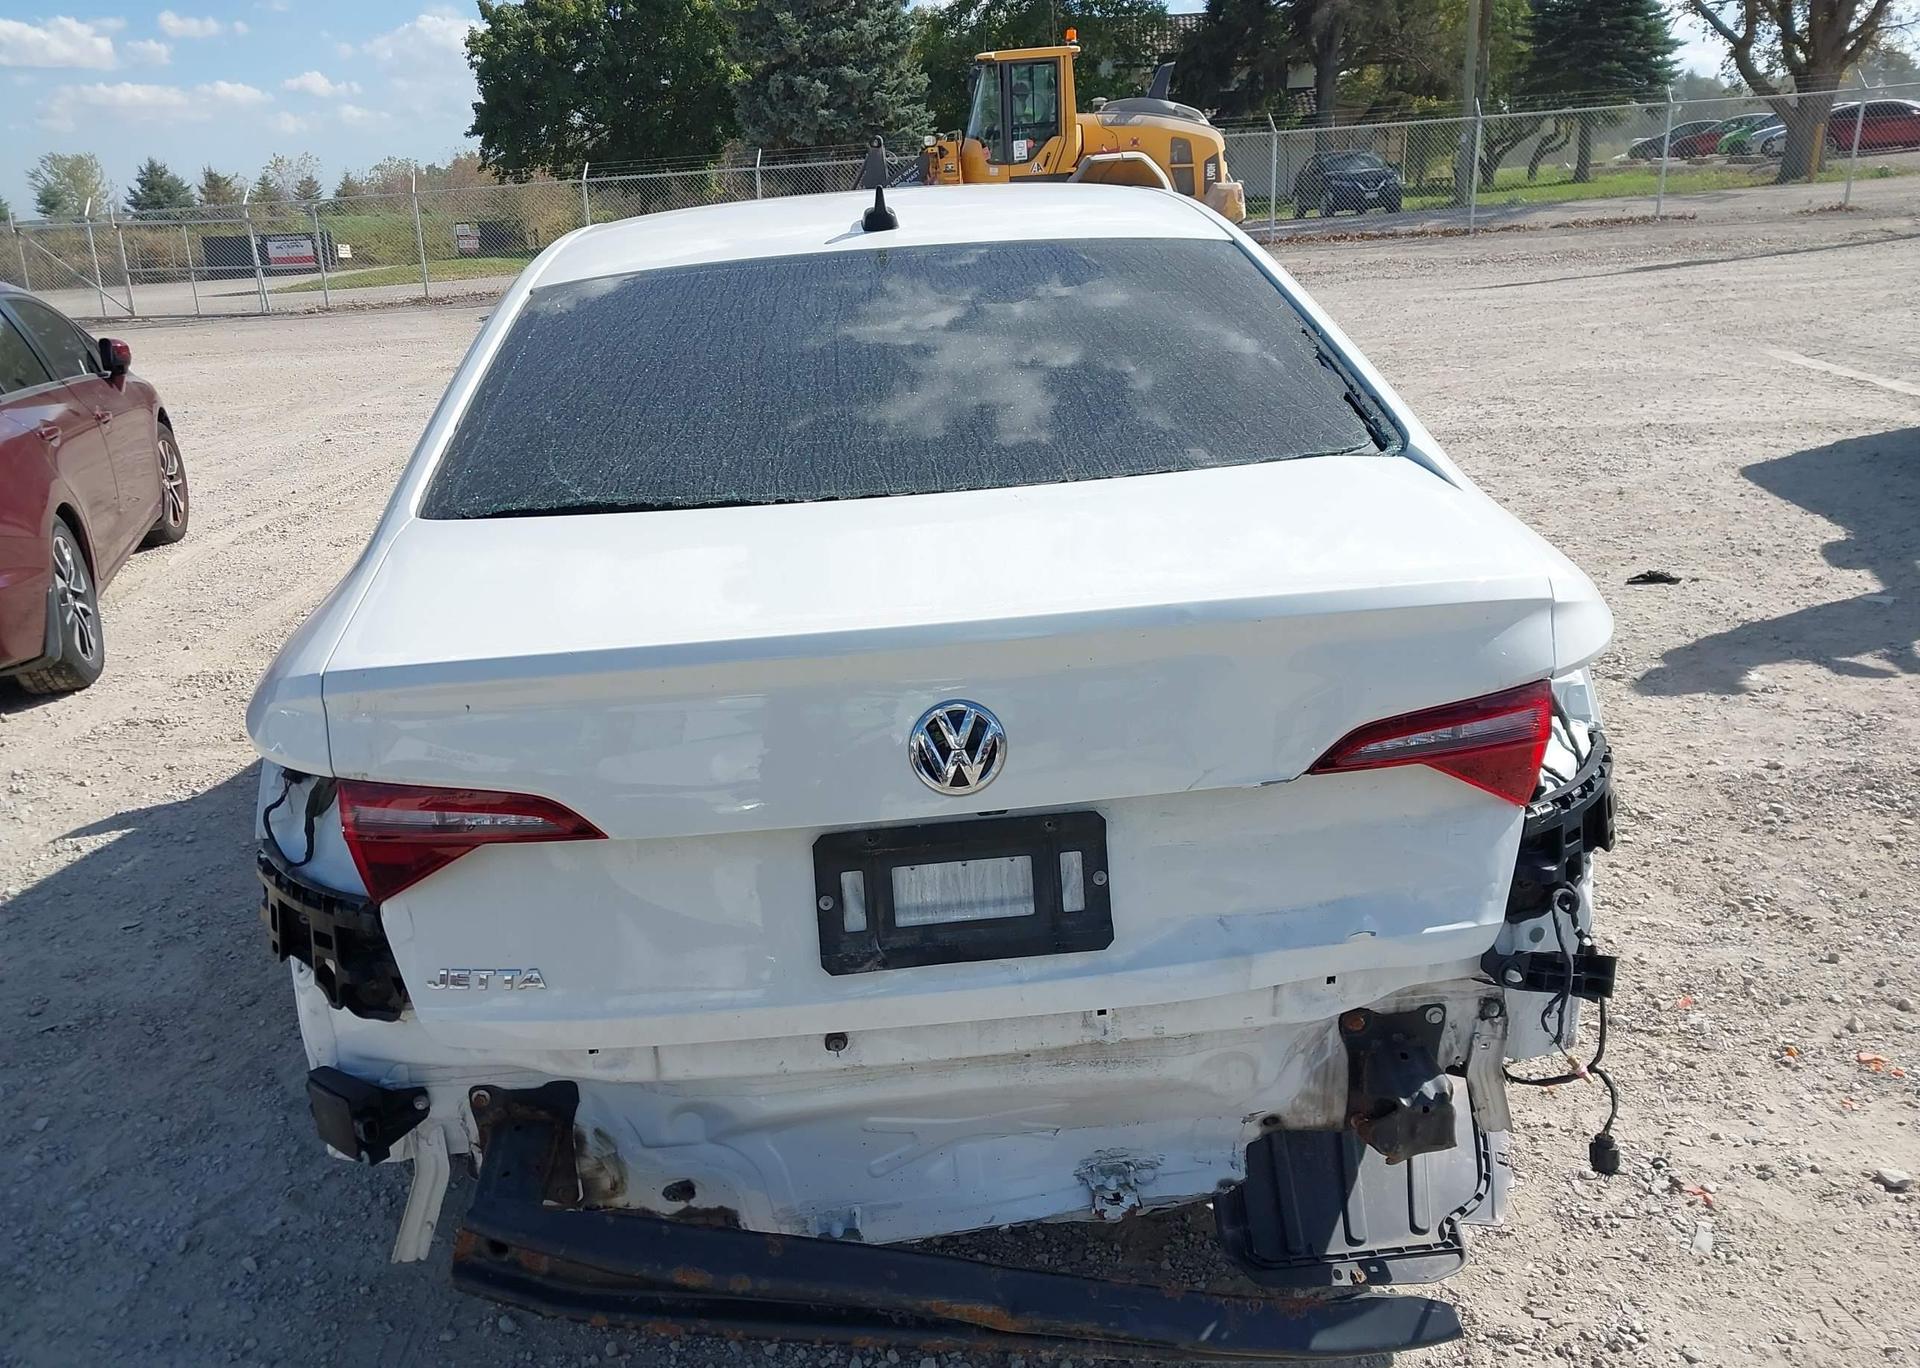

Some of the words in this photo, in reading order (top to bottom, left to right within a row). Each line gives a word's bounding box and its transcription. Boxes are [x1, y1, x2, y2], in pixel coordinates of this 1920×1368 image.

[890, 174, 903, 186] NOT
[902, 163, 919, 177] WALK
[1205, 162, 1216, 180] L90H
[426, 968, 547, 990] JETTA
